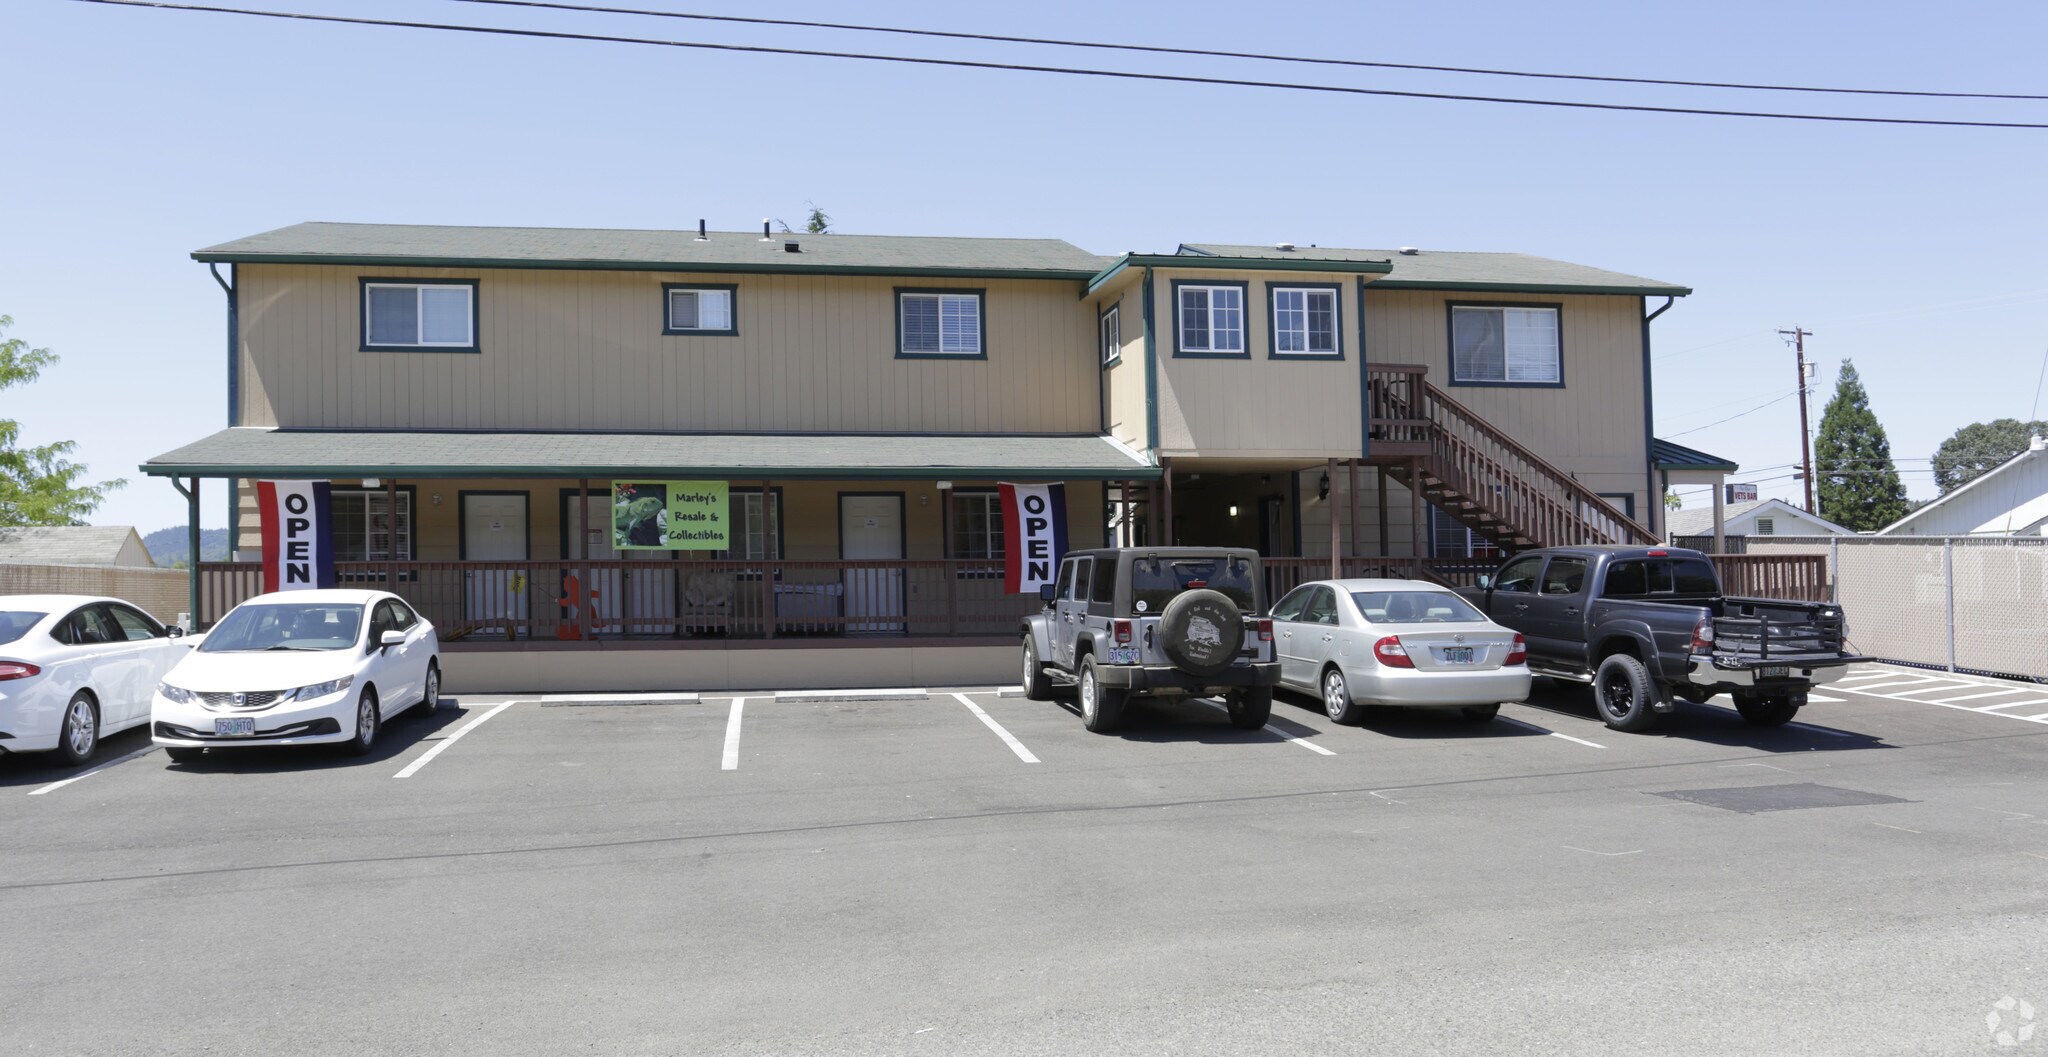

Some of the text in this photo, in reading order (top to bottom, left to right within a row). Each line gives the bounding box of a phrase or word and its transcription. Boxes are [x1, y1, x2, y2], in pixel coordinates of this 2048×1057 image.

[676, 492, 717, 506] Marley's
[1735, 491, 1757, 500] VETS BAR
[674, 511, 719, 522] Resale &
[285, 494, 310, 583] OPEN
[669, 529, 724, 540] Collectibles
[1024, 495, 1048, 581] OPEN
